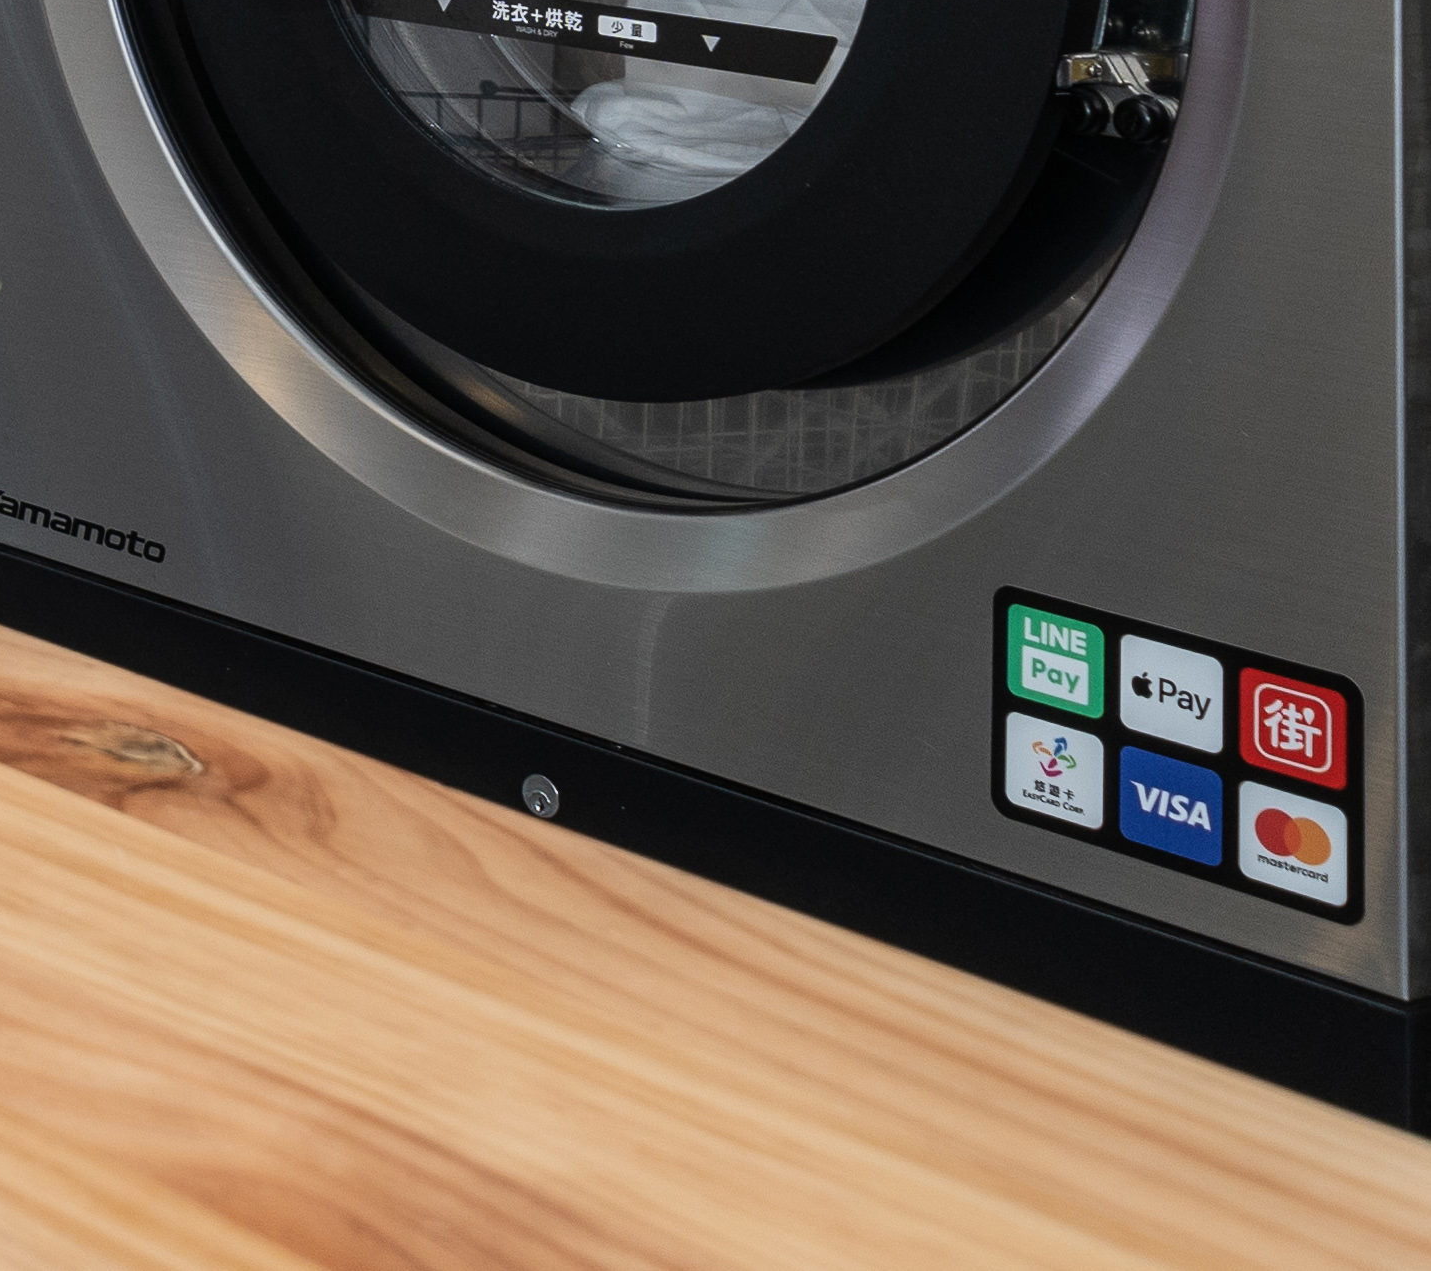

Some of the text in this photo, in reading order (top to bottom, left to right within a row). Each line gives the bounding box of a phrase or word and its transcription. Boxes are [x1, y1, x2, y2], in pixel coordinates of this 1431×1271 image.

[492, 0, 583, 32] 洗衣+烘乾
[515, 25, 558, 38] WASH DRY
[619, 41, 634, 49] Few
[1024, 616, 1087, 656] LINE
[1031, 657, 1080, 694] Pay
[1159, 676, 1211, 720] Pay
[1264, 700, 1322, 758] 街
[1034, 779, 1075, 801] 悠遊卡
[1130, 780, 1212, 832] VISA
[1258, 854, 1329, 884] mastercard
